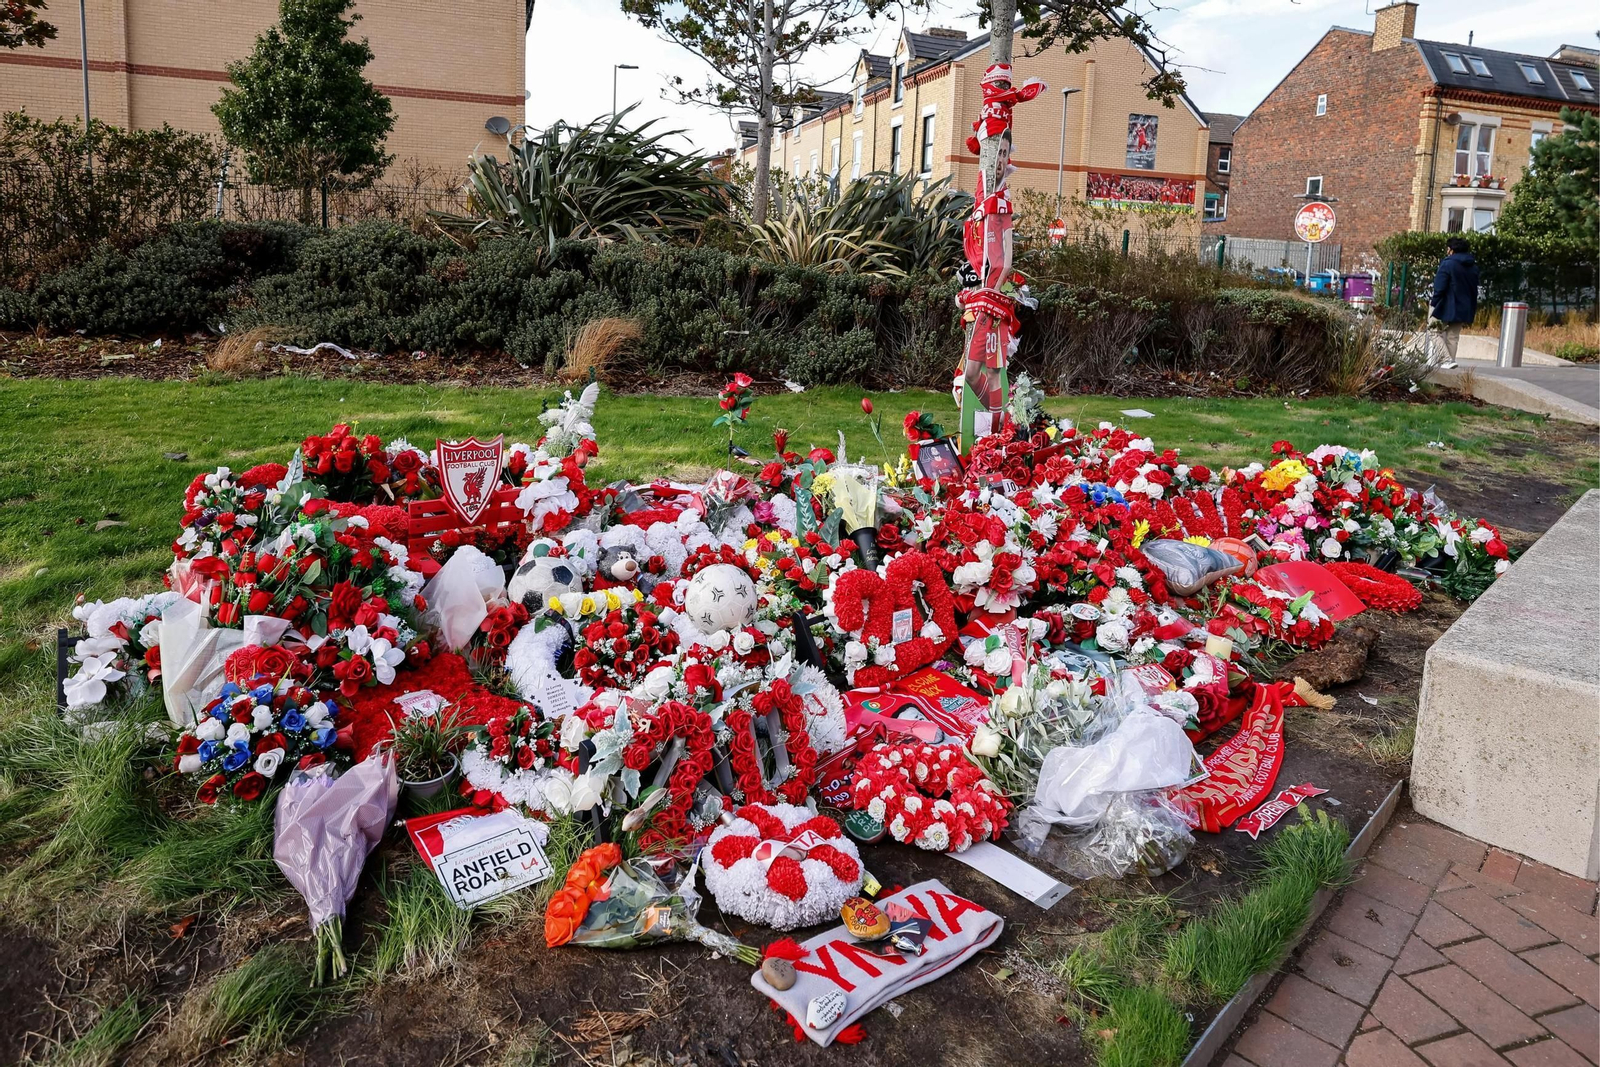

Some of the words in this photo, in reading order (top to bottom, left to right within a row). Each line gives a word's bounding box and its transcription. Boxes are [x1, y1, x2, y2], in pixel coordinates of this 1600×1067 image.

[985, 332, 997, 353] 20
[445, 448, 498, 462] LIVERPOOL
[447, 461, 478, 469] FOOTBALL
[479, 460, 496, 468] CLUB
[1230, 729, 1251, 751] LEAGUE
[1254, 755, 1276, 784] FOOTBALL
[1266, 732, 1281, 753] CLUB
[453, 842, 532, 882] ANFIELD
[521, 857, 539, 871] L4
[454, 866, 508, 895] ROAD
